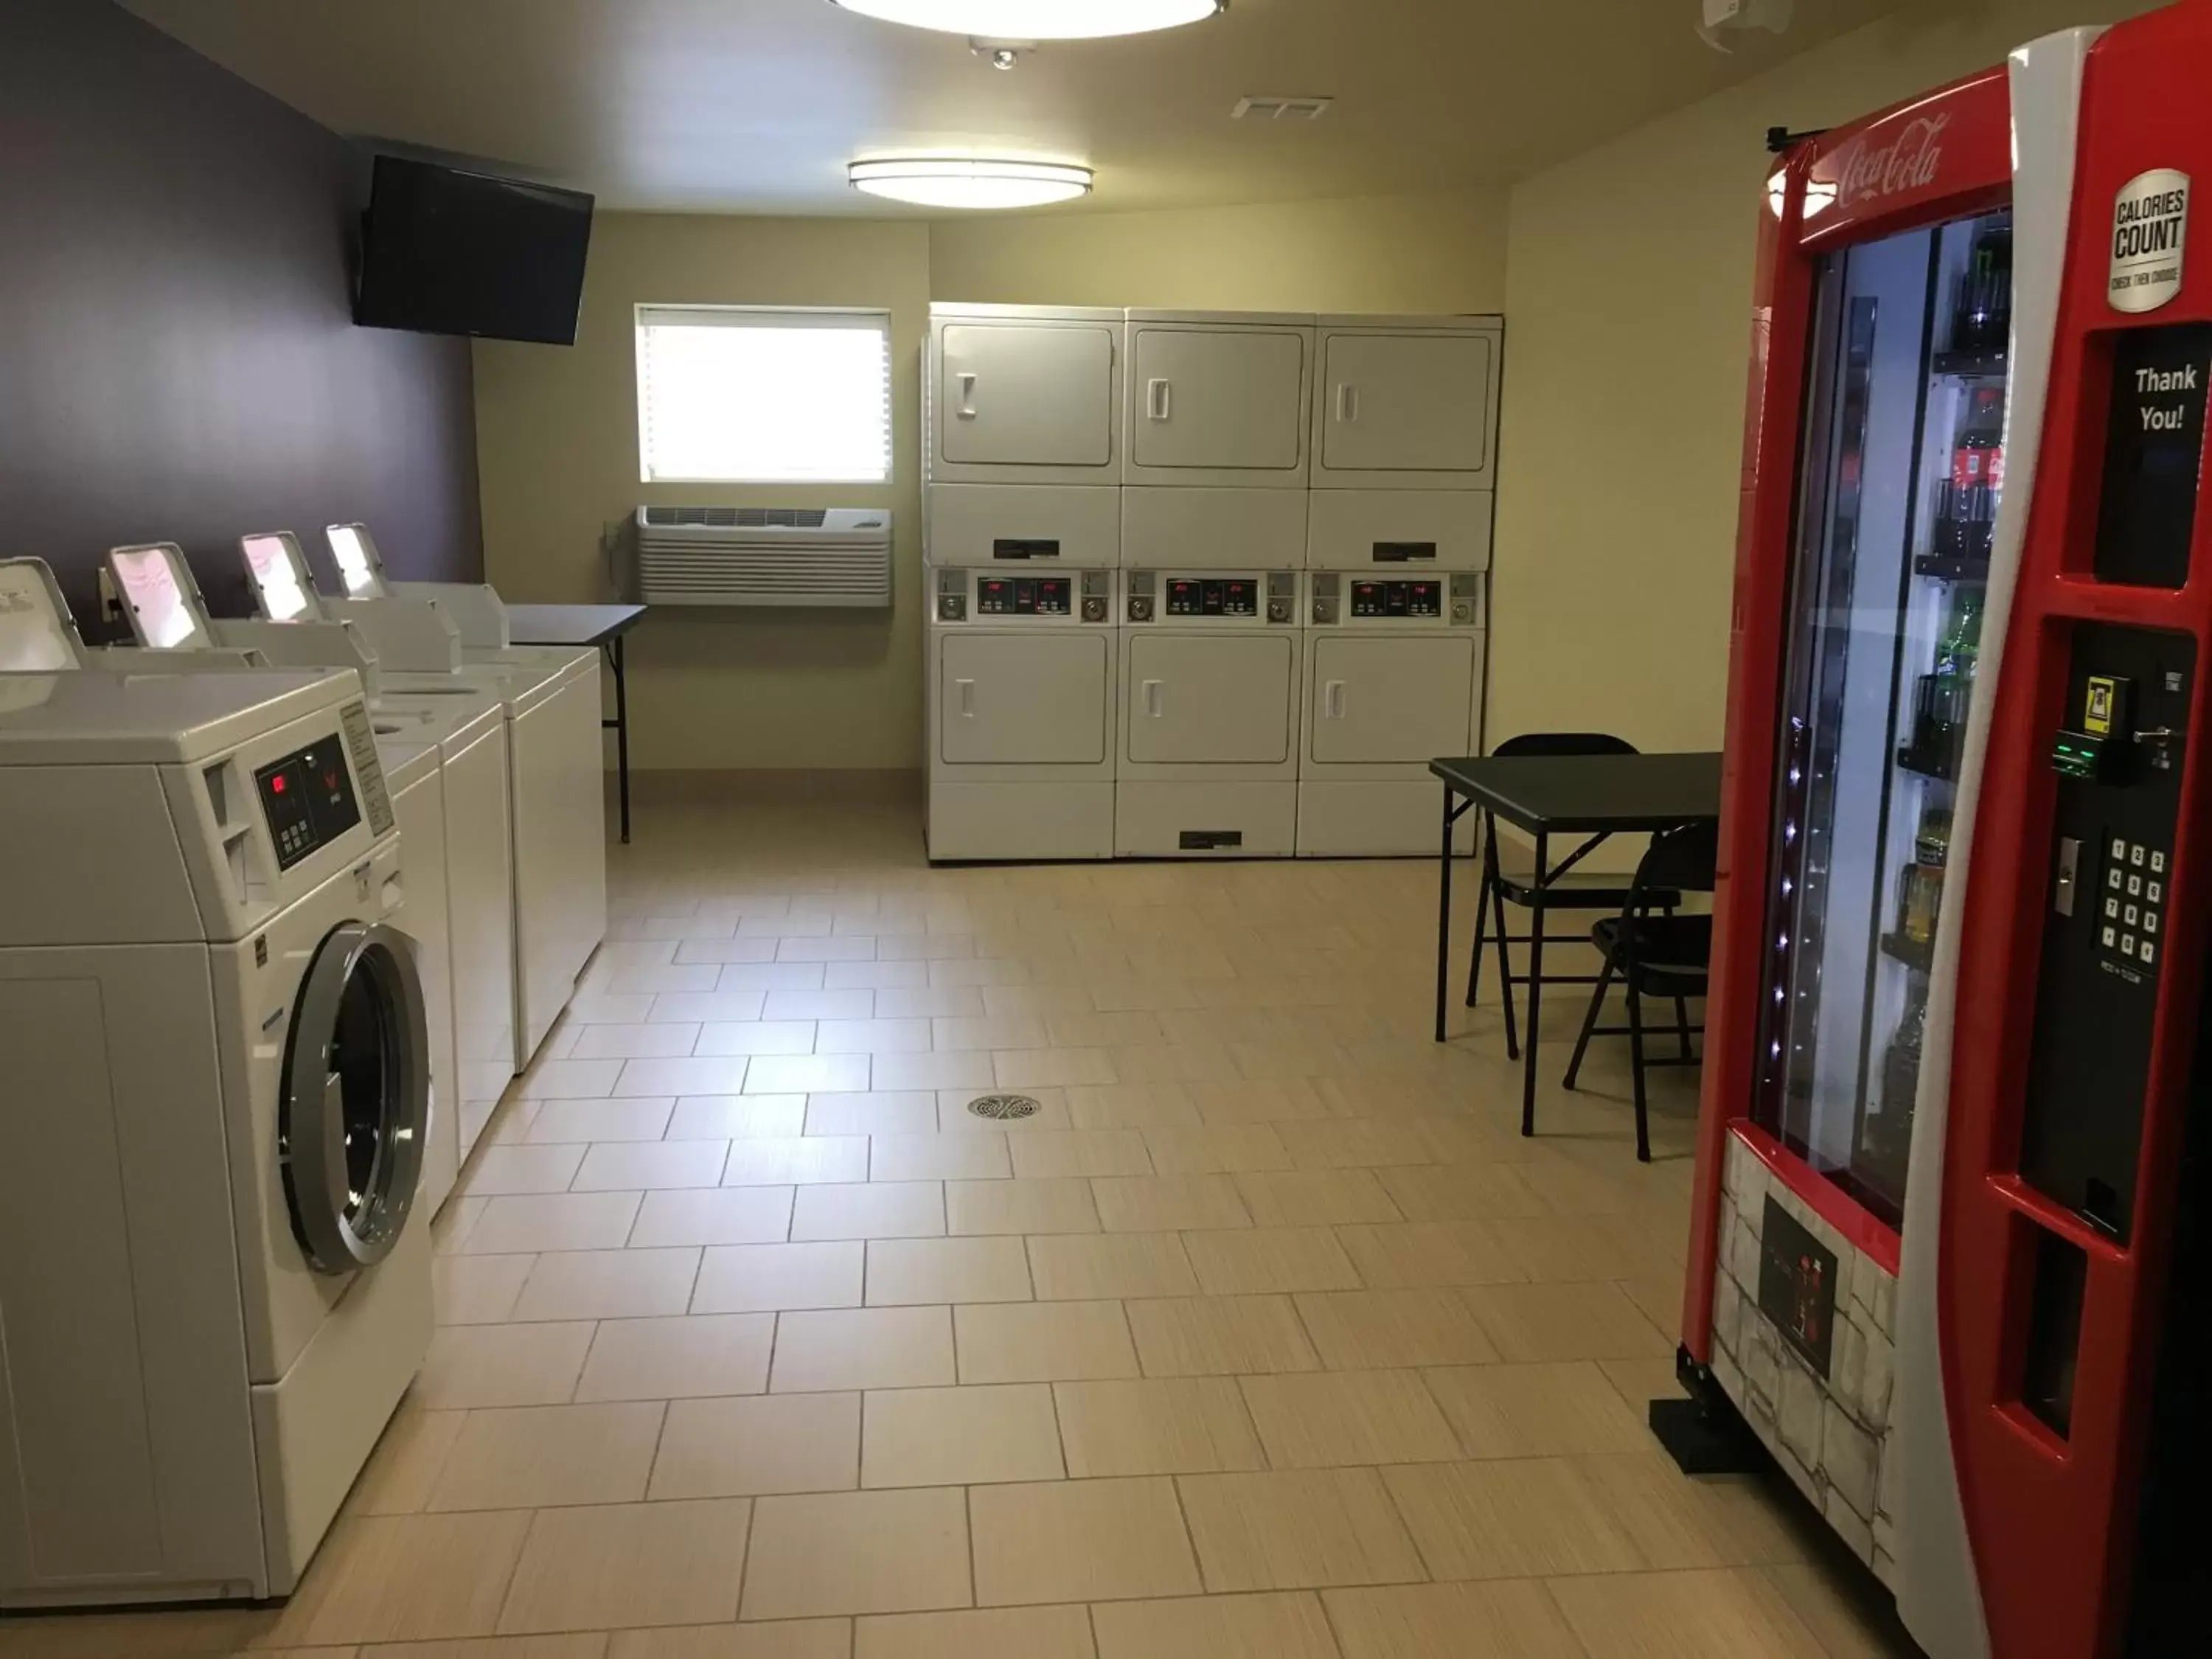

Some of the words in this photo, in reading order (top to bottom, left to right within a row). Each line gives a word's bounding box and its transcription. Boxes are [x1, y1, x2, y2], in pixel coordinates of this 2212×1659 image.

[2117, 189, 2185, 225] CALORIES
[2115, 215, 2183, 259] COUNT
[2135, 364, 2197, 393] Thank
[2140, 404, 2185, 431] You!
